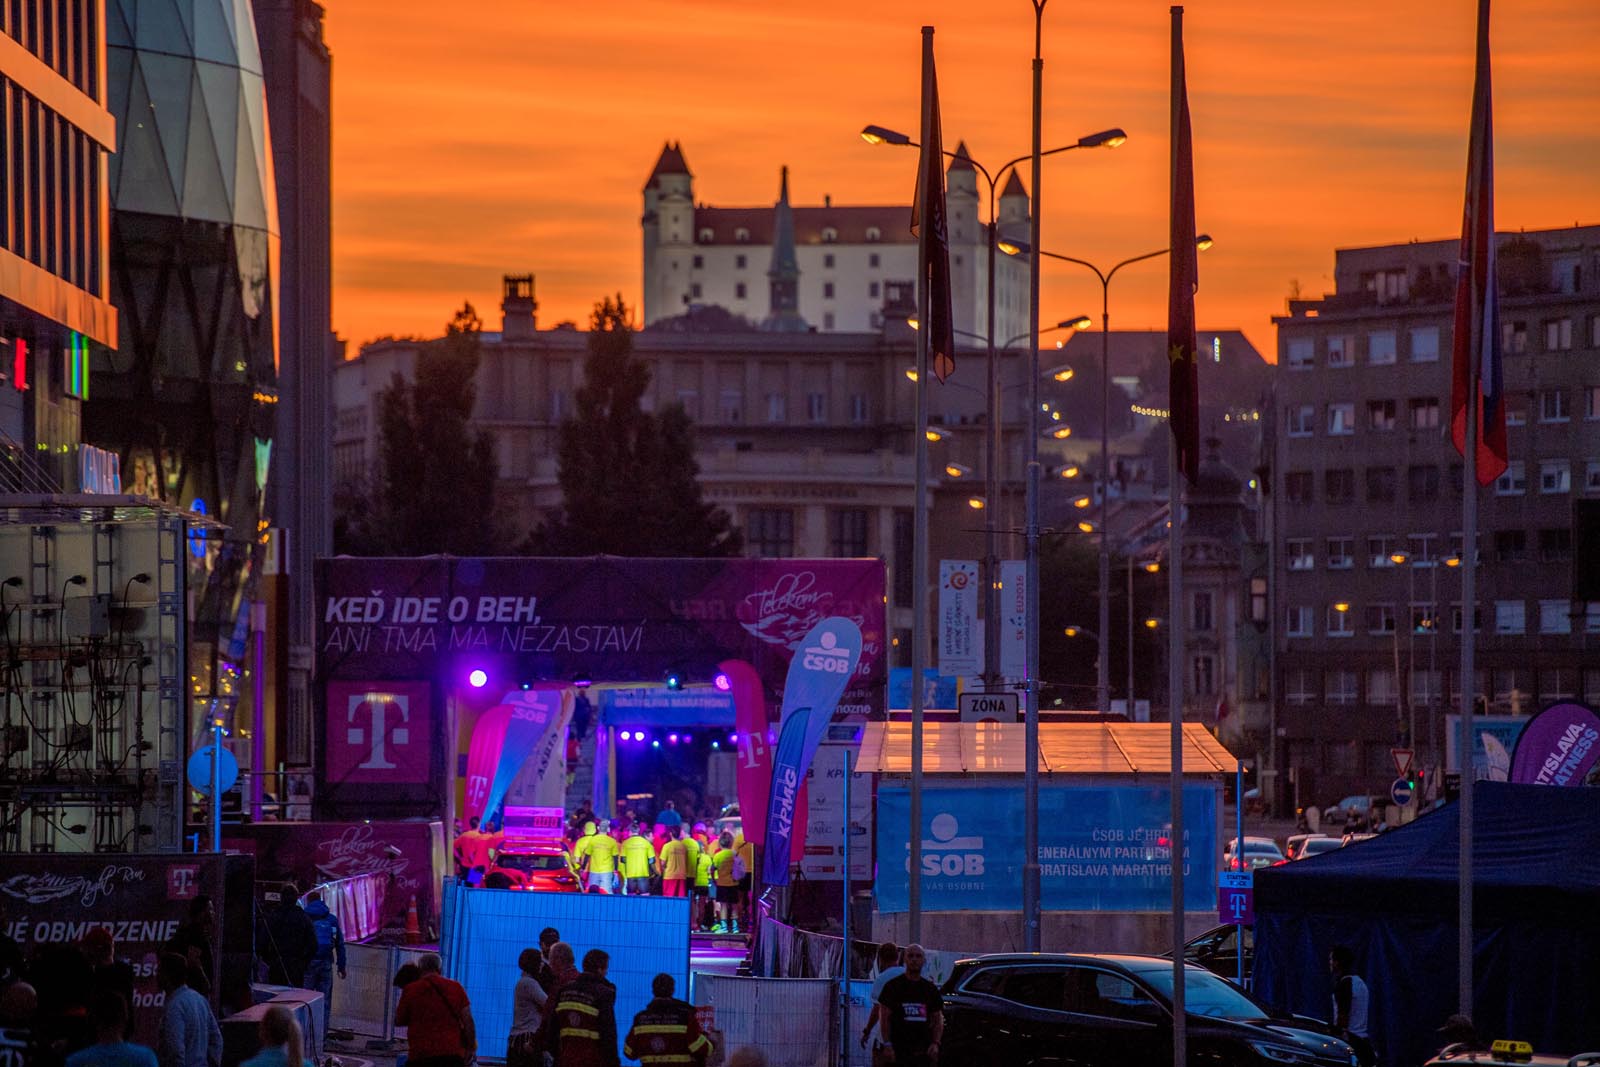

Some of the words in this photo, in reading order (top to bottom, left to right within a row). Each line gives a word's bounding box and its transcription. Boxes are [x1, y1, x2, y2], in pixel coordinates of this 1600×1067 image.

[325, 589, 385, 623] KEĎ
[392, 597, 442, 623] IDE
[447, 596, 470, 623] O
[475, 596, 542, 626] BEH,
[1015, 575, 1025, 614] EU2016
[324, 626, 372, 652] ANI
[381, 626, 437, 652] TMA
[448, 625, 489, 651] MA
[500, 618, 648, 653] NEZASTAVÍ
[1015, 628, 1025, 641] SK
[802, 653, 850, 674] ČSOB
[511, 705, 547, 725] SOB
[347, 692, 409, 769] T
[738, 732, 764, 769] T
[1550, 728, 1599, 786] ATNESS
[826, 768, 863, 779] KPG
[468, 775, 488, 808] T
[776, 768, 797, 839] KPMG
[1092, 827, 1124, 842] ČSOB
[1127, 830, 1142, 842] JE
[1145, 829, 1190, 842] HRDM
[1037, 845, 1112, 859] ENERÁLNYM
[1114, 847, 1190, 859] PARTNERM
[172, 868, 195, 896] T
[1112, 863, 1190, 877] MARATHOU
[1230, 893, 1247, 919] T
